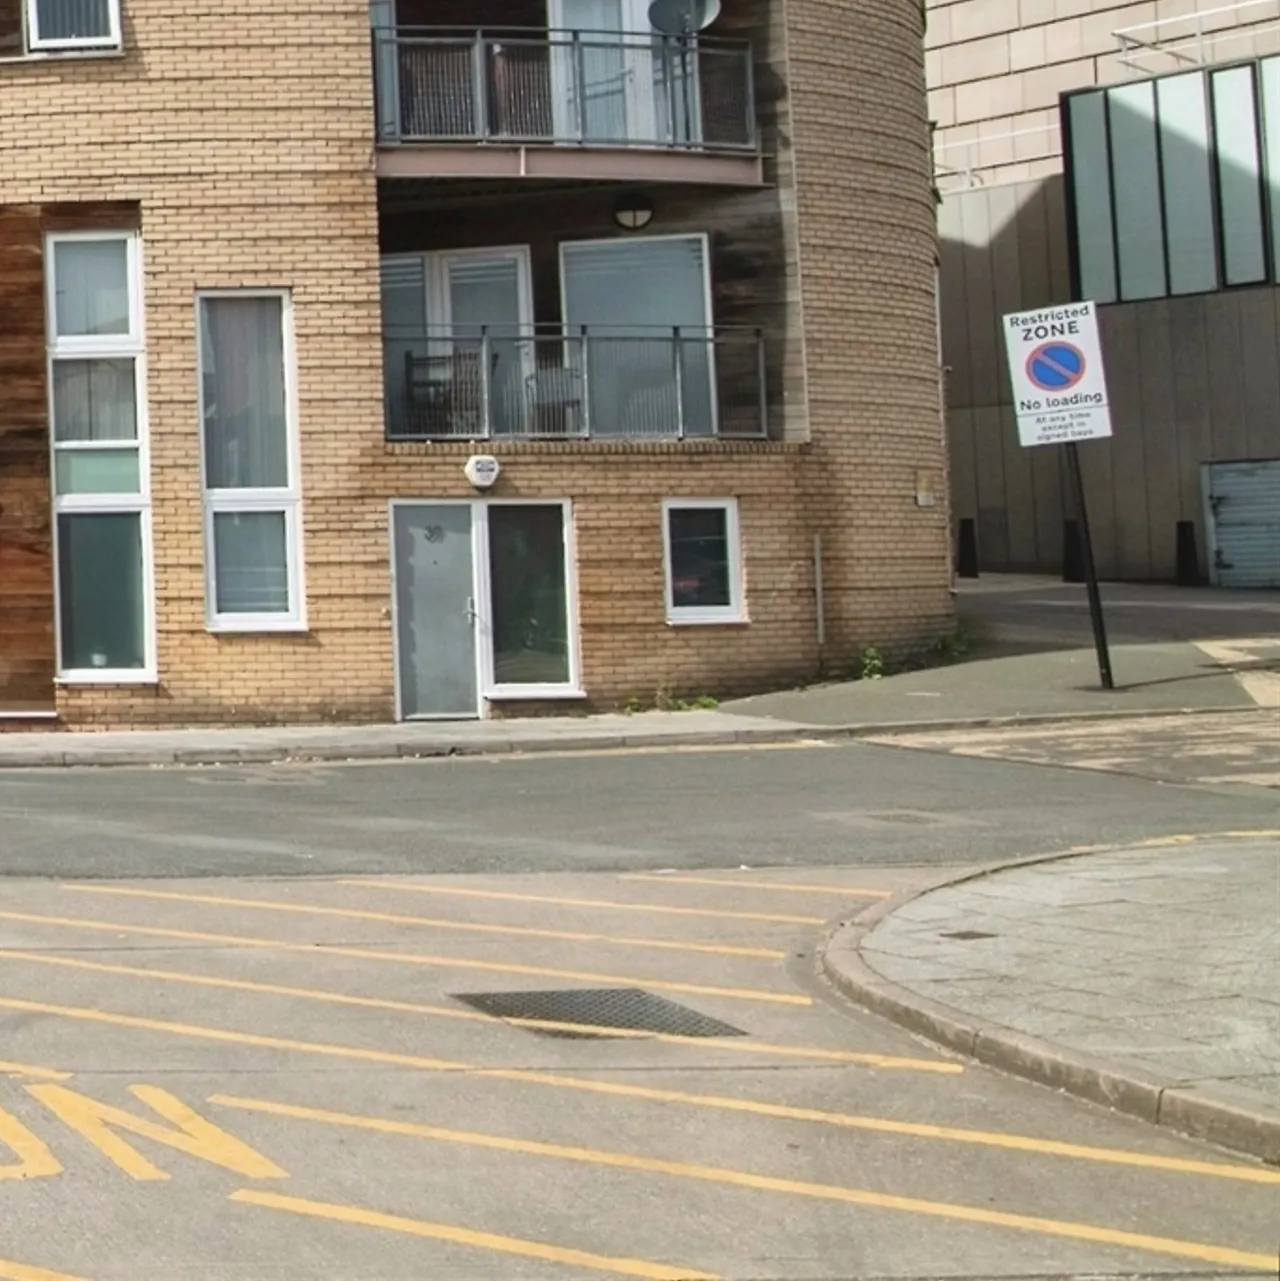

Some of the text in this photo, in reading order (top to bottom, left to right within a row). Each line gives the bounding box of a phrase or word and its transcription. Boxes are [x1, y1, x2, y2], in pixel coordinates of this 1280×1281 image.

[1009, 305, 1090, 328] Restricted
[1021, 320, 1080, 341] ZONE
[1020, 392, 1103, 411] No loading
